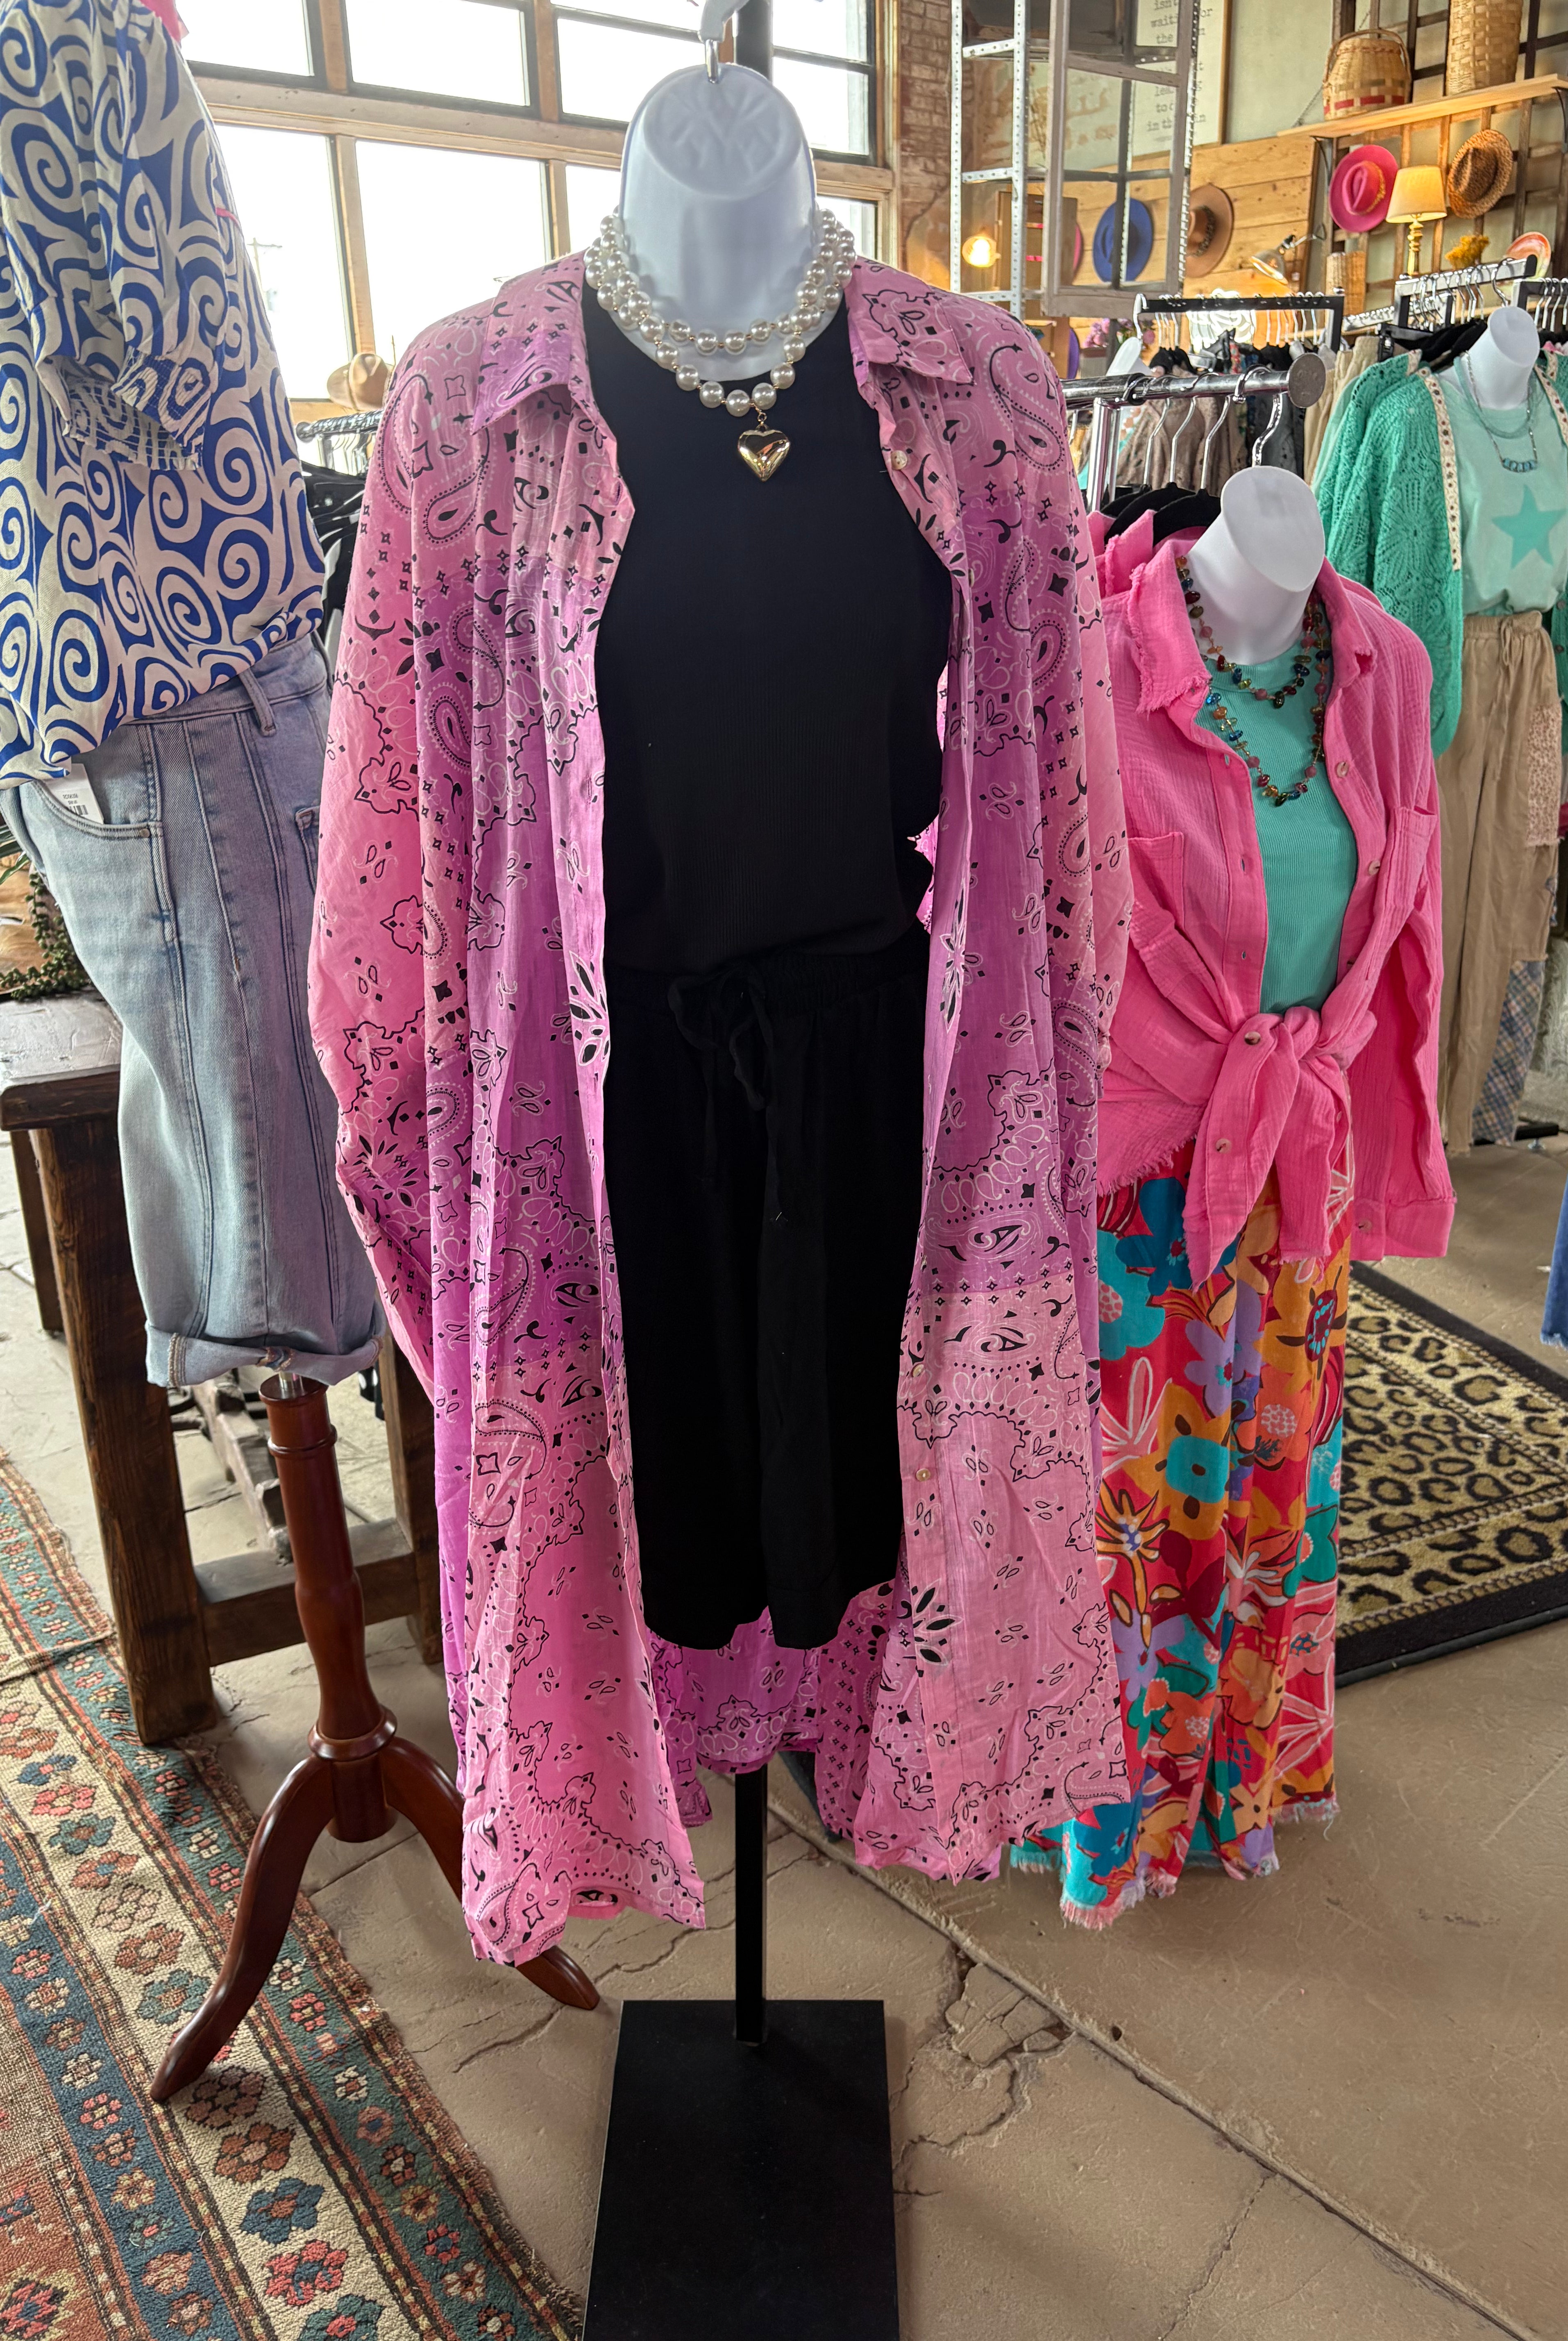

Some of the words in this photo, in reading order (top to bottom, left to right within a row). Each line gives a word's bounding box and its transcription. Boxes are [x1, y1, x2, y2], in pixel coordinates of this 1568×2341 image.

[1154, 0, 1177, 10] isnt
[1156, 34, 1173, 44] the
[1147, 120, 1159, 131] in
